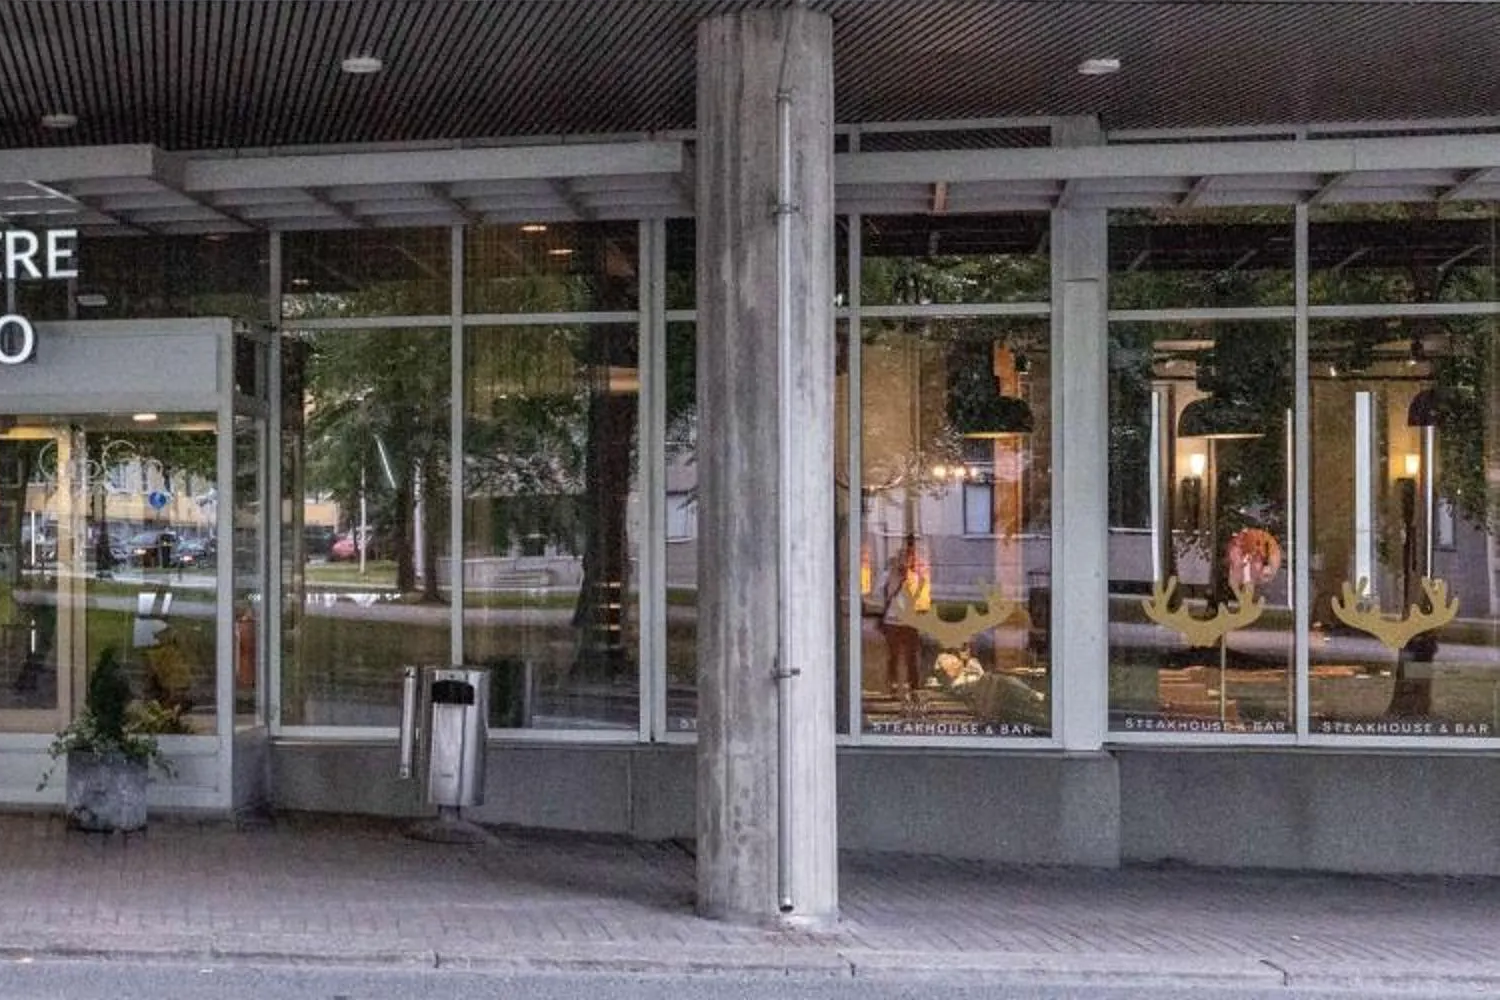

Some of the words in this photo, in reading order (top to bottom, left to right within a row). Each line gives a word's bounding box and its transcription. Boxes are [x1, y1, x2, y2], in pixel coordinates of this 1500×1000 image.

[872, 723, 978, 735] STEAKHOUSE
[1001, 723, 1033, 735] BAR
[1125, 718, 1230, 731] STEAKHOUSE
[1322, 721, 1432, 733] STEAKHOUSE
[1455, 722, 1489, 734] BAR
